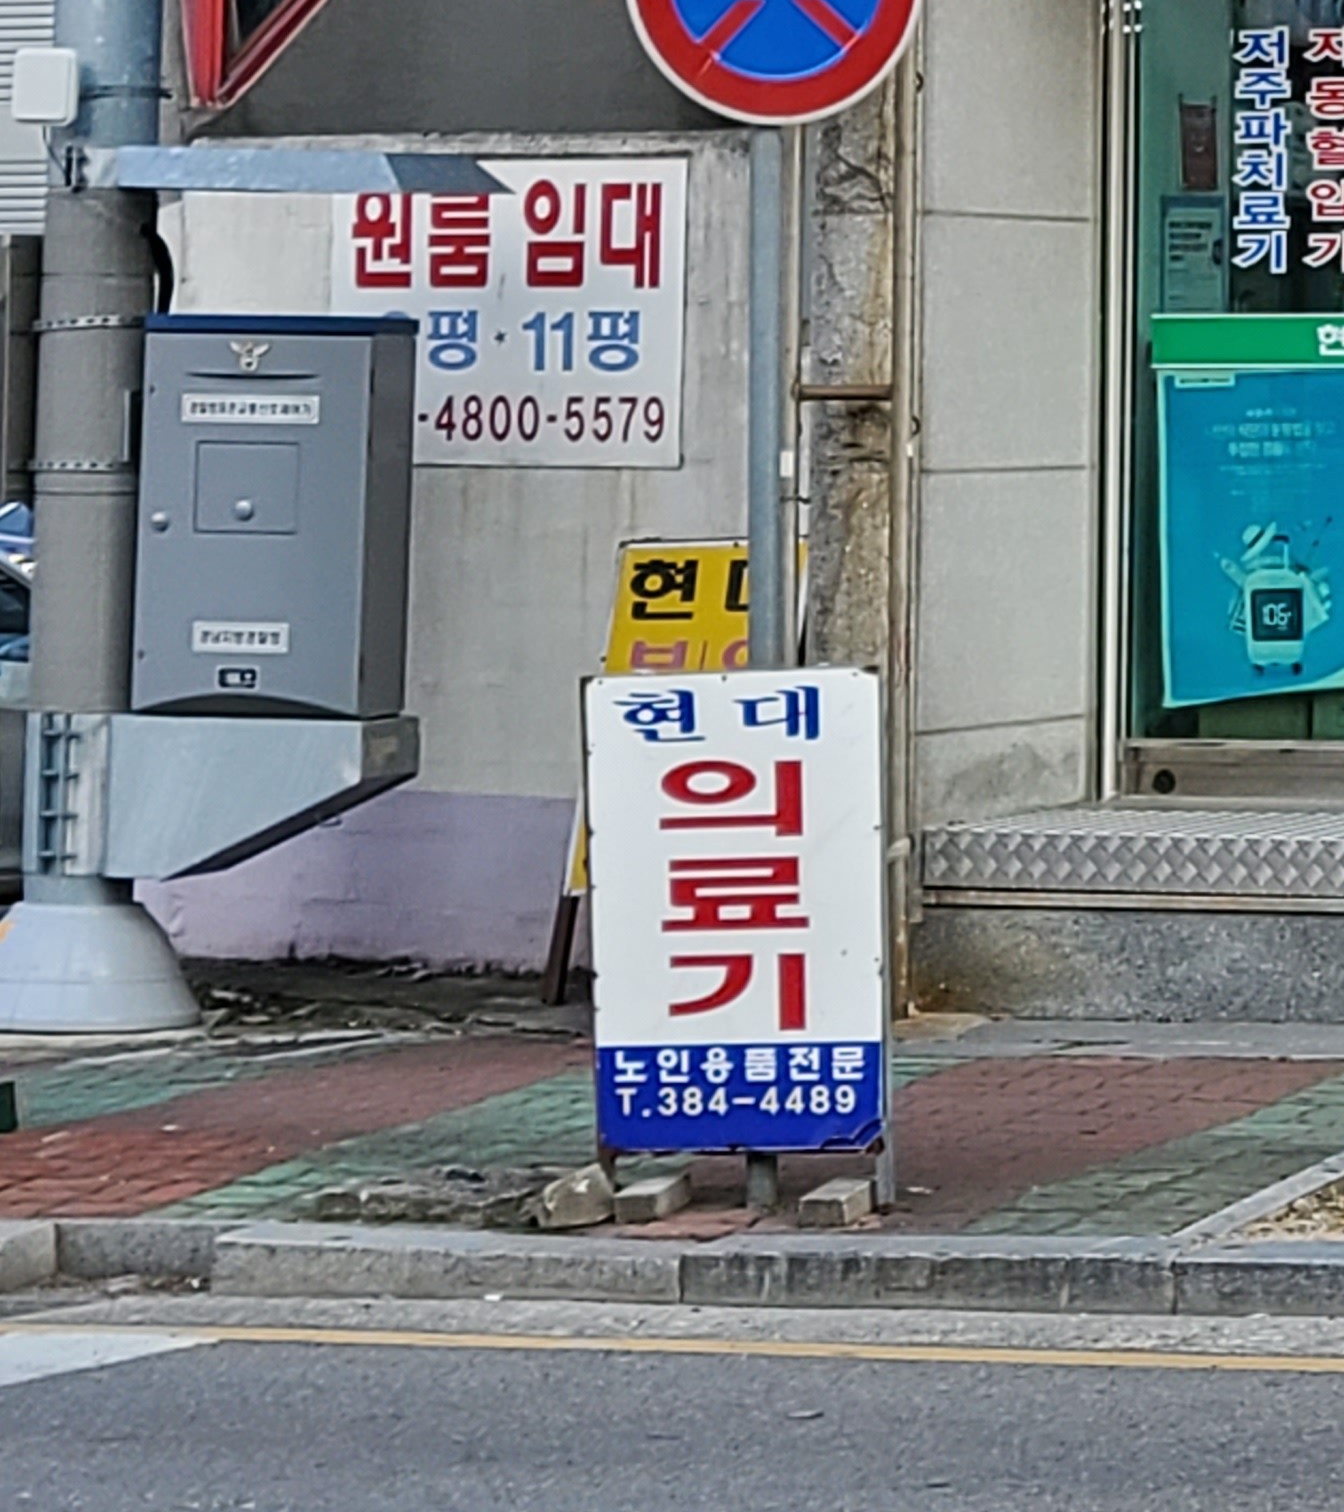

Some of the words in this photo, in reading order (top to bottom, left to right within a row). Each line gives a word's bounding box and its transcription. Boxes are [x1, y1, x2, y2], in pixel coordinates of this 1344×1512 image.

[1233, 28, 1291, 272] 저주파치료기
[352, 190, 490, 288] 원룸
[524, 179, 662, 288] 임대
[657, 759, 811, 1032] 의료기
[613, 1047, 866, 1084] 노인용품전문
[615, 1085, 858, 1118] T.384-4489
